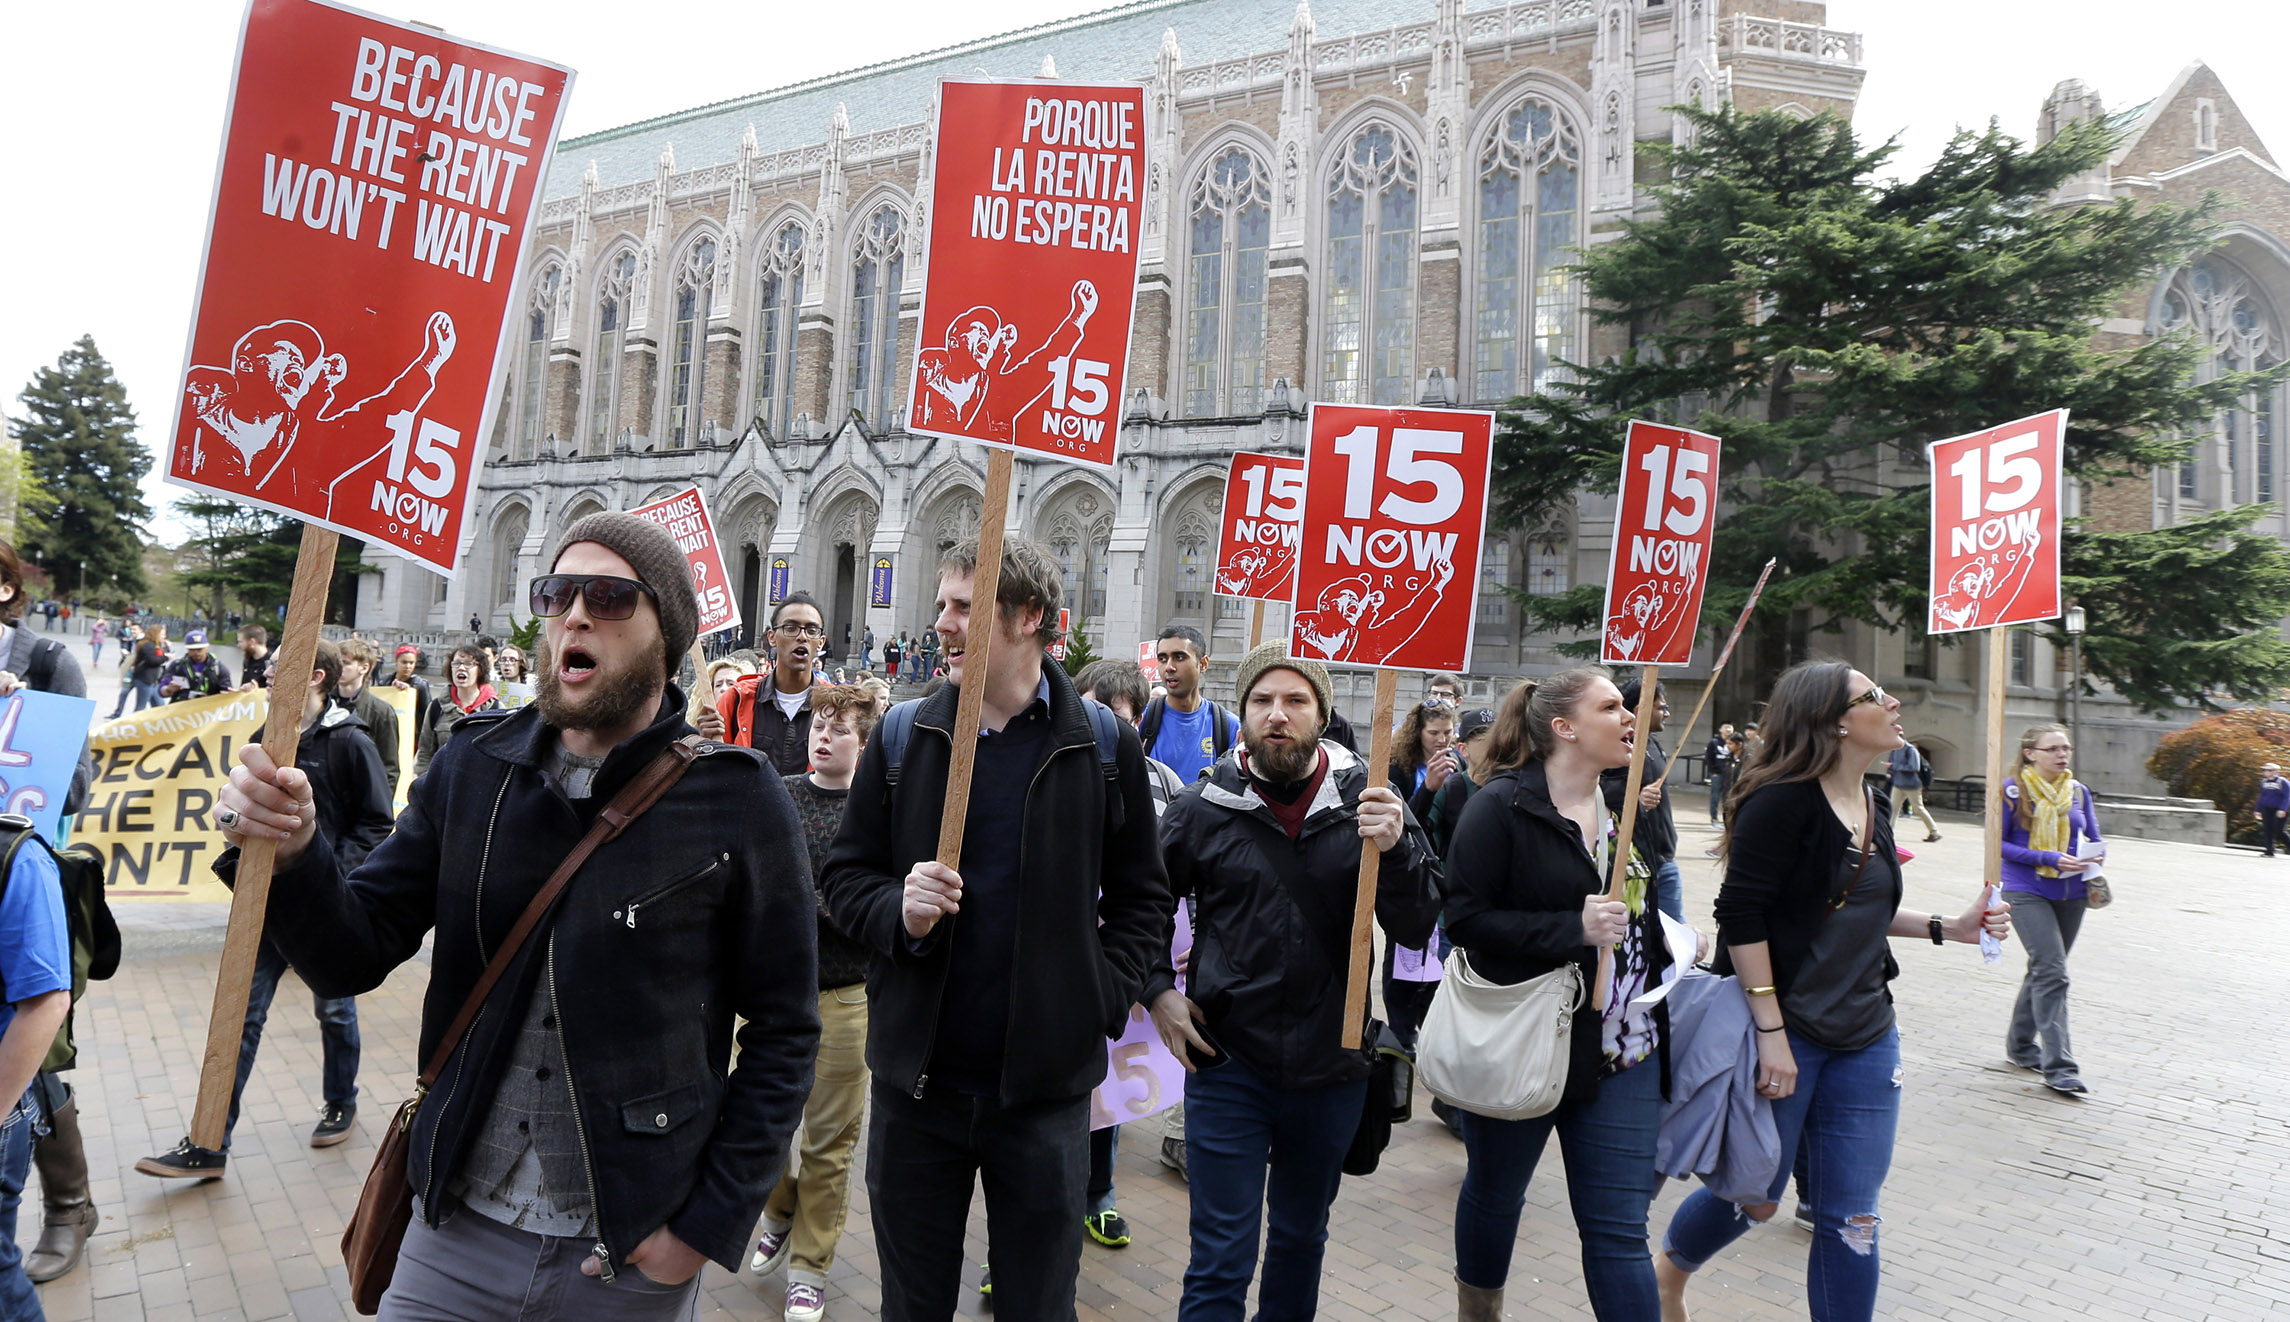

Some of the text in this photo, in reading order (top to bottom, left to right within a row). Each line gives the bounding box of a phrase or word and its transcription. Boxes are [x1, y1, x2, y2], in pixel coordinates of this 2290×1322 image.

[350, 36, 545, 148] BECAUSE
[1022, 98, 1135, 150] PORQUE
[330, 100, 527, 215] THE RENT
[991, 147, 1134, 202] LA RENTA
[261, 153, 510, 283] WON'T WAIT
[971, 195, 1129, 254] NO ESPERA
[1048, 355, 1110, 416] 15
[1042, 412, 1105, 444] NOW
[384, 409, 462, 500] 15
[1334, 425, 1465, 525] 15
[1951, 430, 2043, 521] 15
[371, 480, 450, 538] NOW
[640, 494, 700, 524] BECAUSE
[1241, 464, 1303, 522] 15
[1641, 444, 1709, 536] 15
[669, 512, 705, 540] RENT
[675, 530, 709, 555] WAIT
[1234, 519, 1299, 548] NOW
[1324, 524, 1459, 571] NOW
[1951, 508, 2042, 558] NOW
[1629, 535, 1702, 577] NOW
[696, 584, 726, 614] 15
[773, 569, 782, 602] Welcome
[874, 569, 886, 604] Welcome
[700, 605, 728, 626] NOW
[143, 701, 255, 737] MINIMUM
[74, 789, 154, 833] HE
